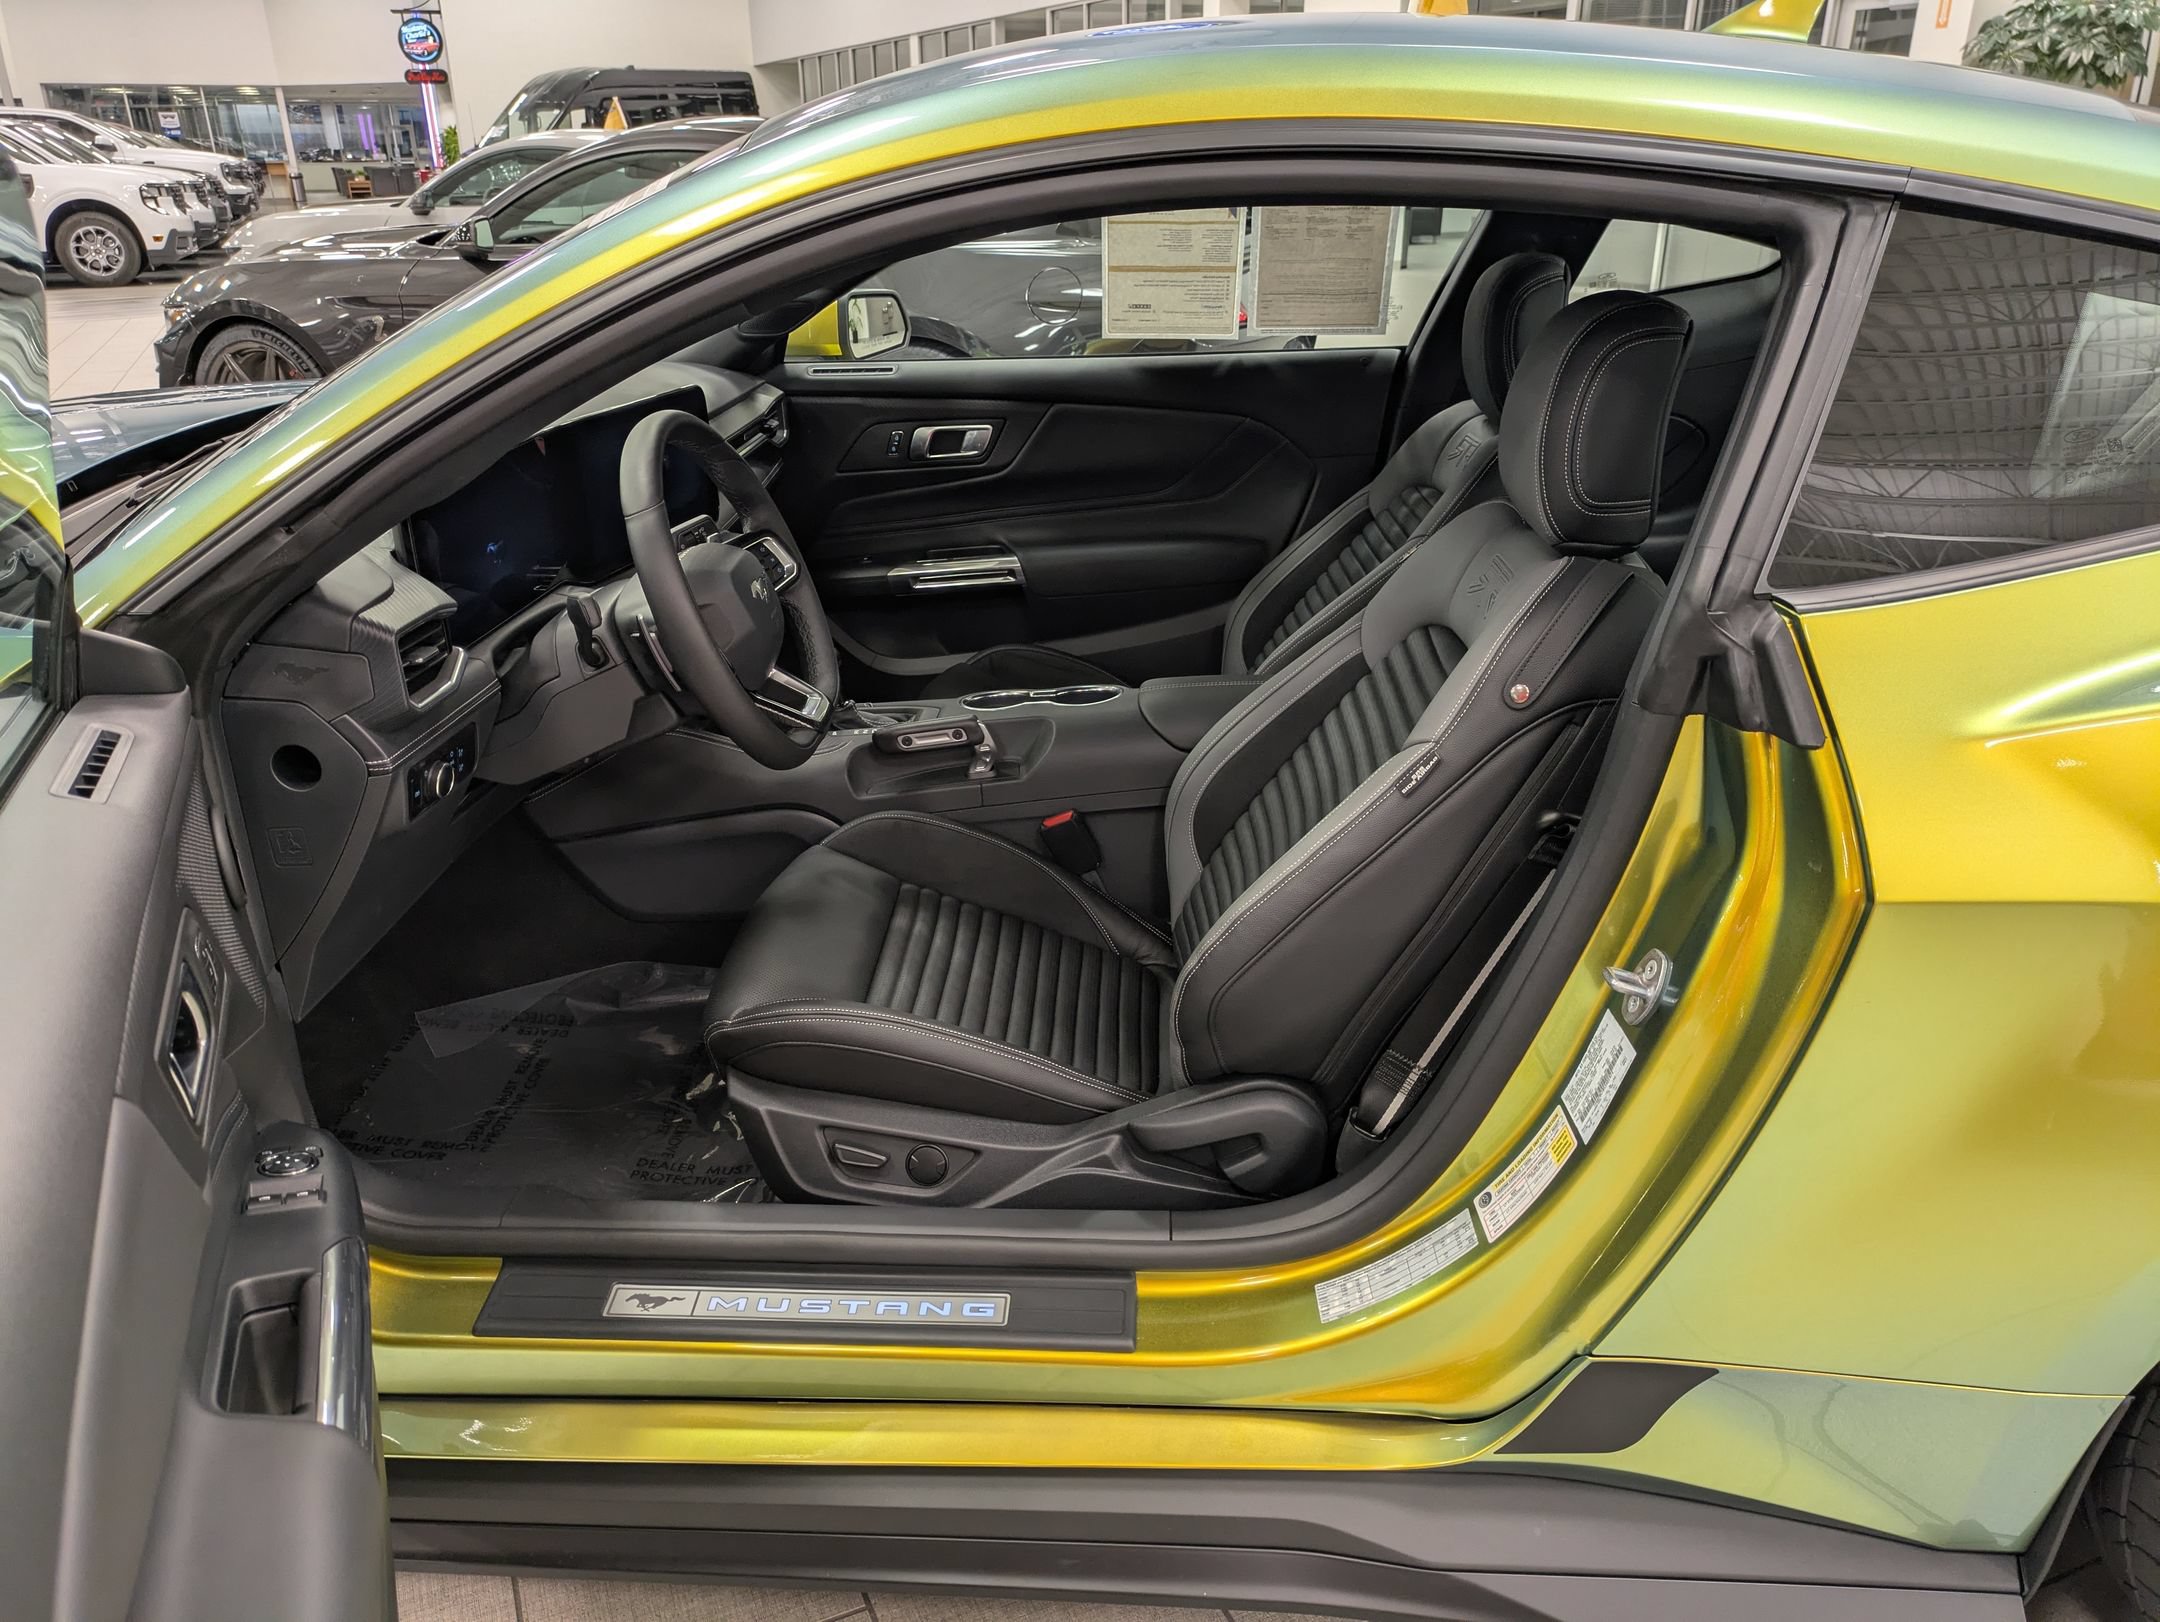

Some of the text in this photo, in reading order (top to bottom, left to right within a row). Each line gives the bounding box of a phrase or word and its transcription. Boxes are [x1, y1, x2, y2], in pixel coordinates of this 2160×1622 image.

[635, 1157, 753, 1175] DEALER MUST
[629, 1169, 727, 1186] PROTECTIVE
[707, 1296, 996, 1318] MUSTANG
